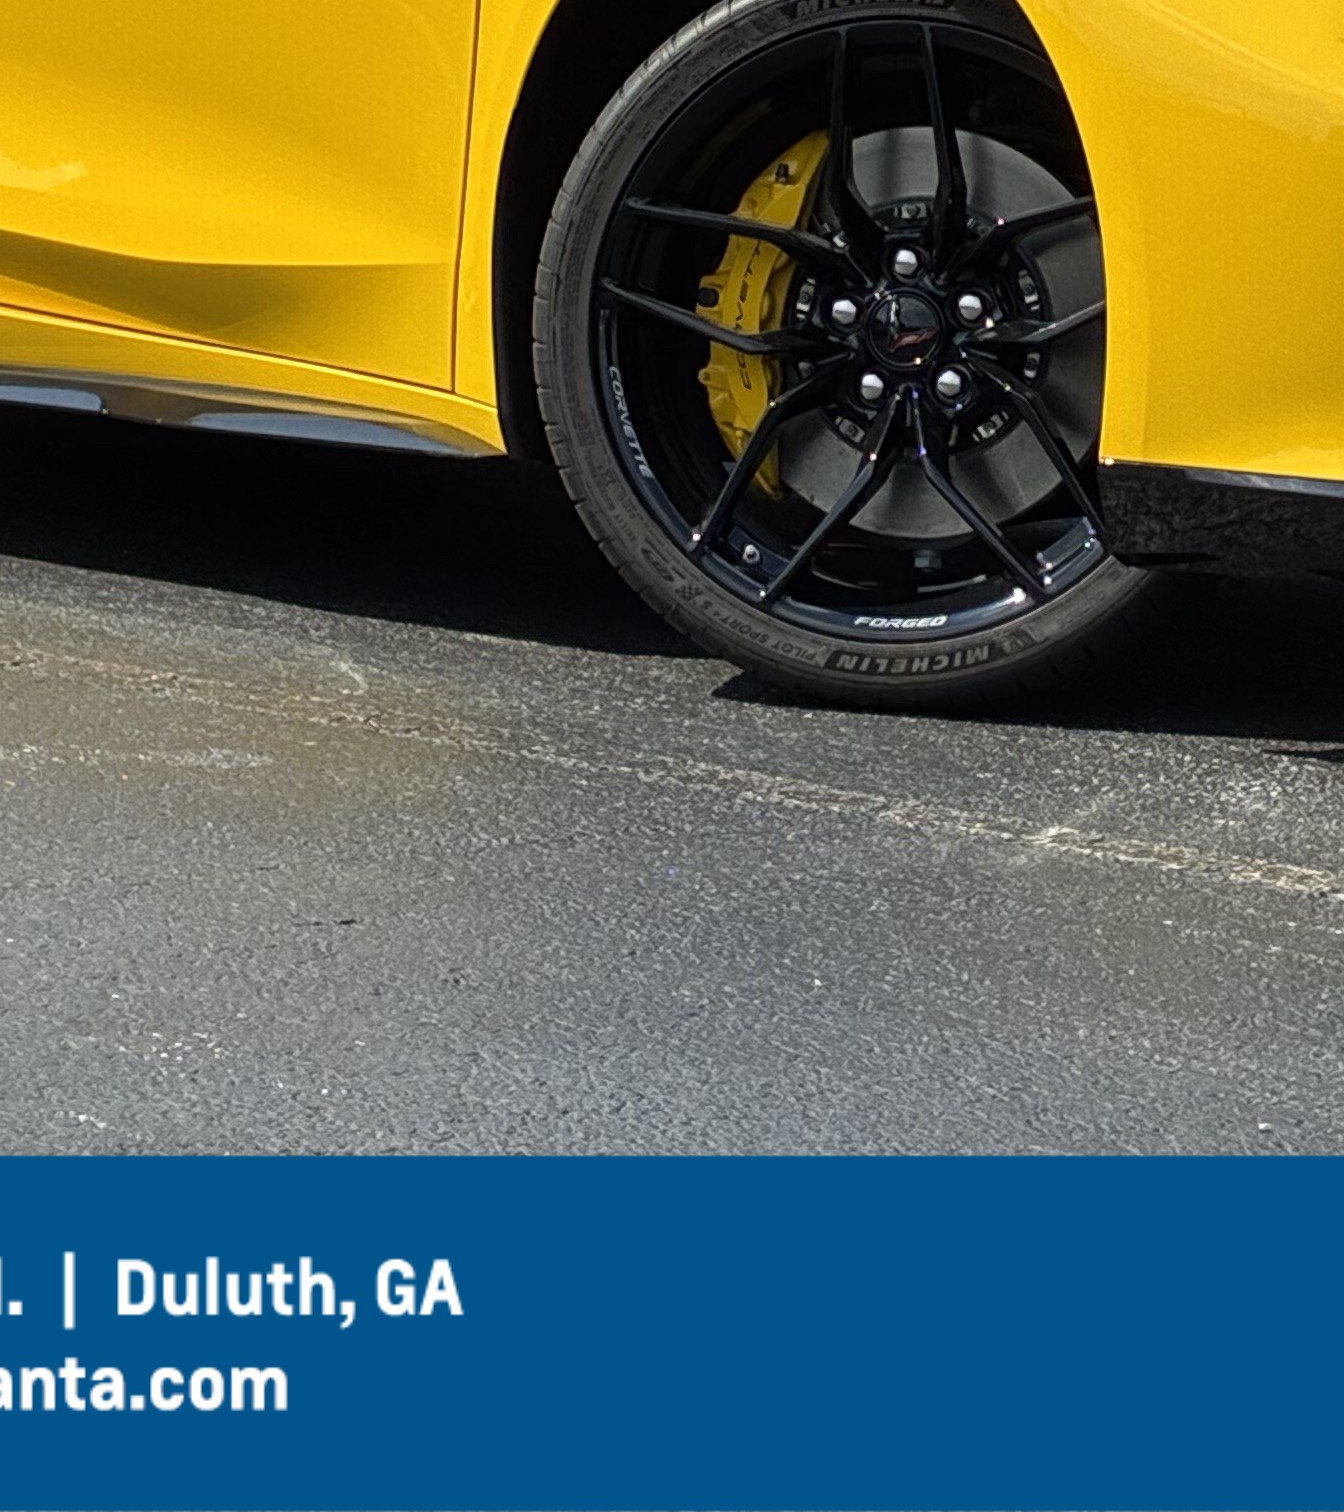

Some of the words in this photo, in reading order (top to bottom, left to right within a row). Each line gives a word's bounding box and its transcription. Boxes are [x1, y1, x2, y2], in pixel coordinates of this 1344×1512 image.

[608, 365, 655, 479] CORVETTE
[720, 613, 770, 644] SPORT
[854, 614, 949, 629] FORGED
[769, 640, 817, 661] PILOT
[834, 644, 990, 675] MICHELIN
